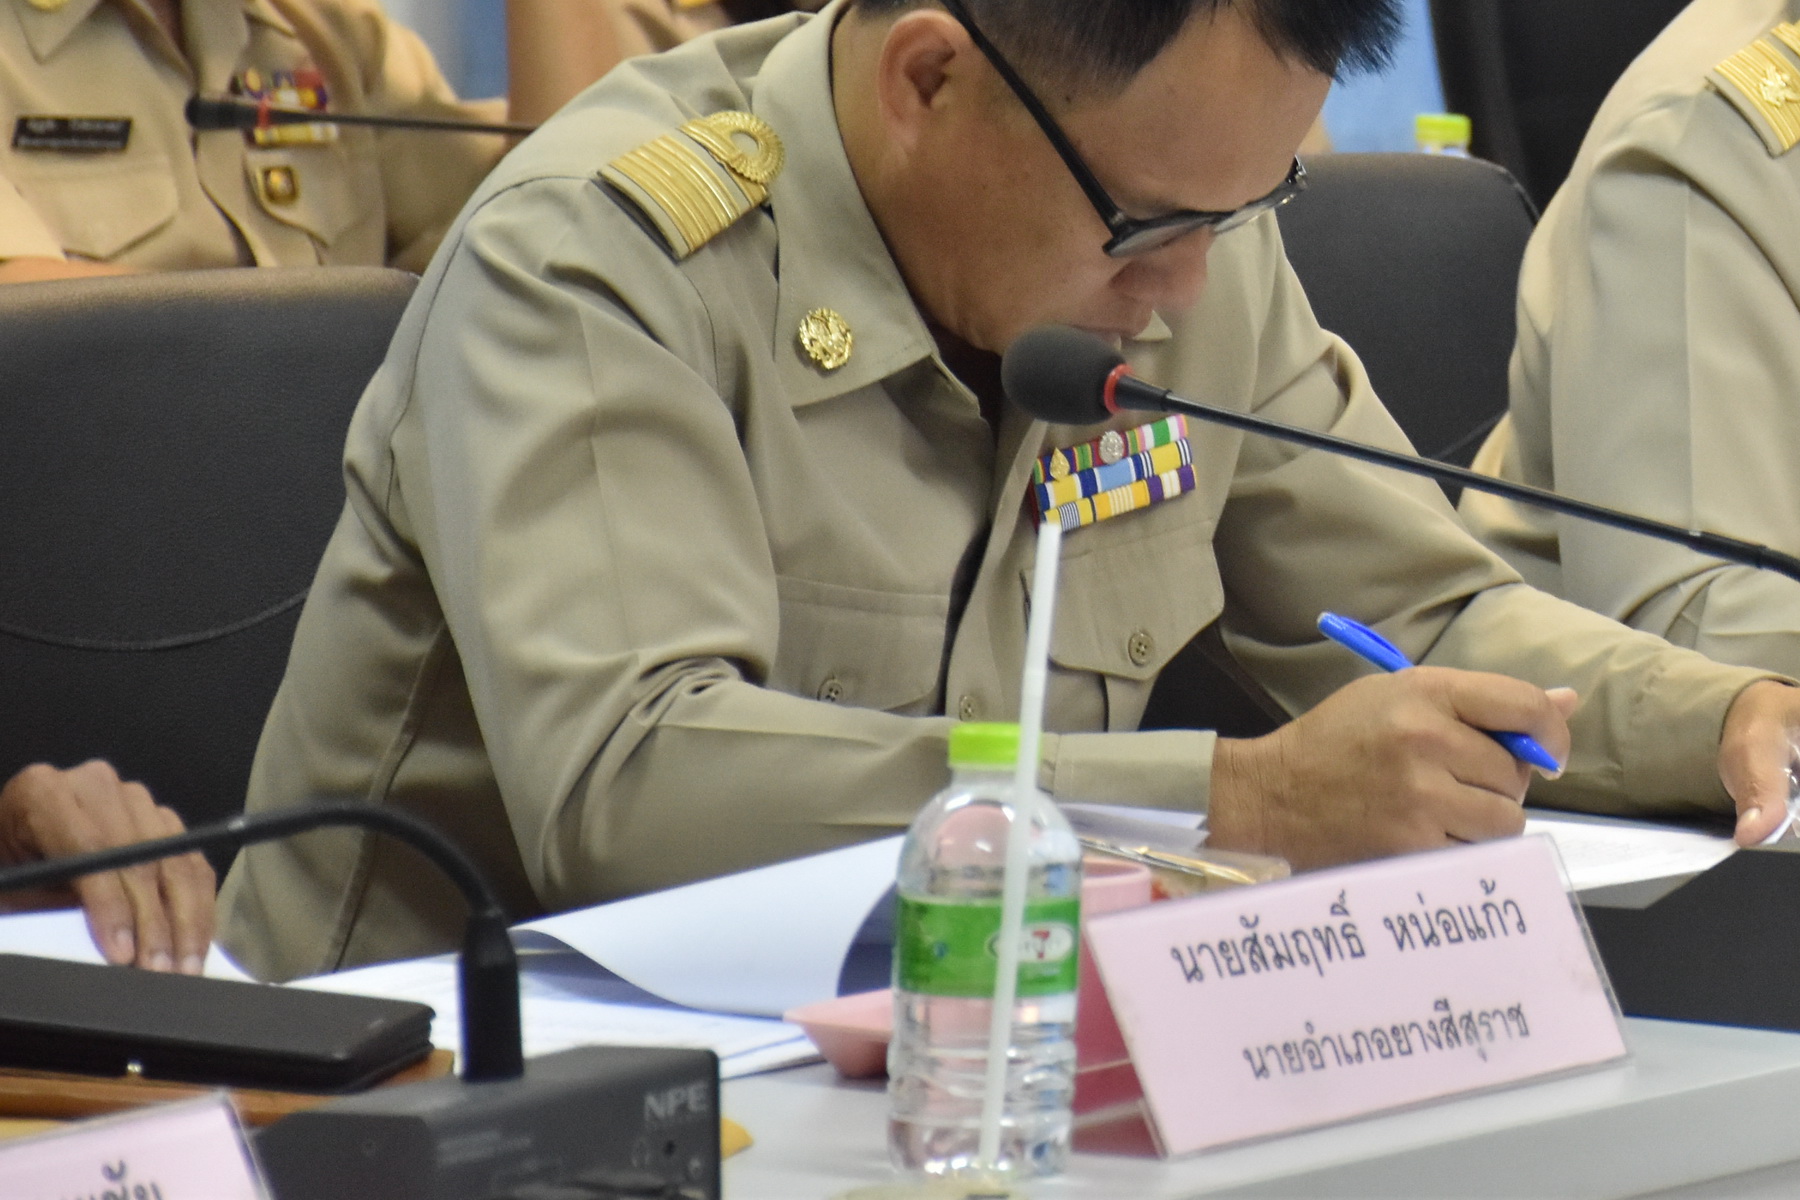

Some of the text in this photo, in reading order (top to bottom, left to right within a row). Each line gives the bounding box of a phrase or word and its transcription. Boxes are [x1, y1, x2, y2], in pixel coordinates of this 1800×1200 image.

[1170, 879, 1526, 983] นายสัมฤทธิ์ หน่อแก้ว
[1243, 998, 1531, 1080] นายอำเภอยางสีสุราช
[643, 1083, 708, 1120] NPE
